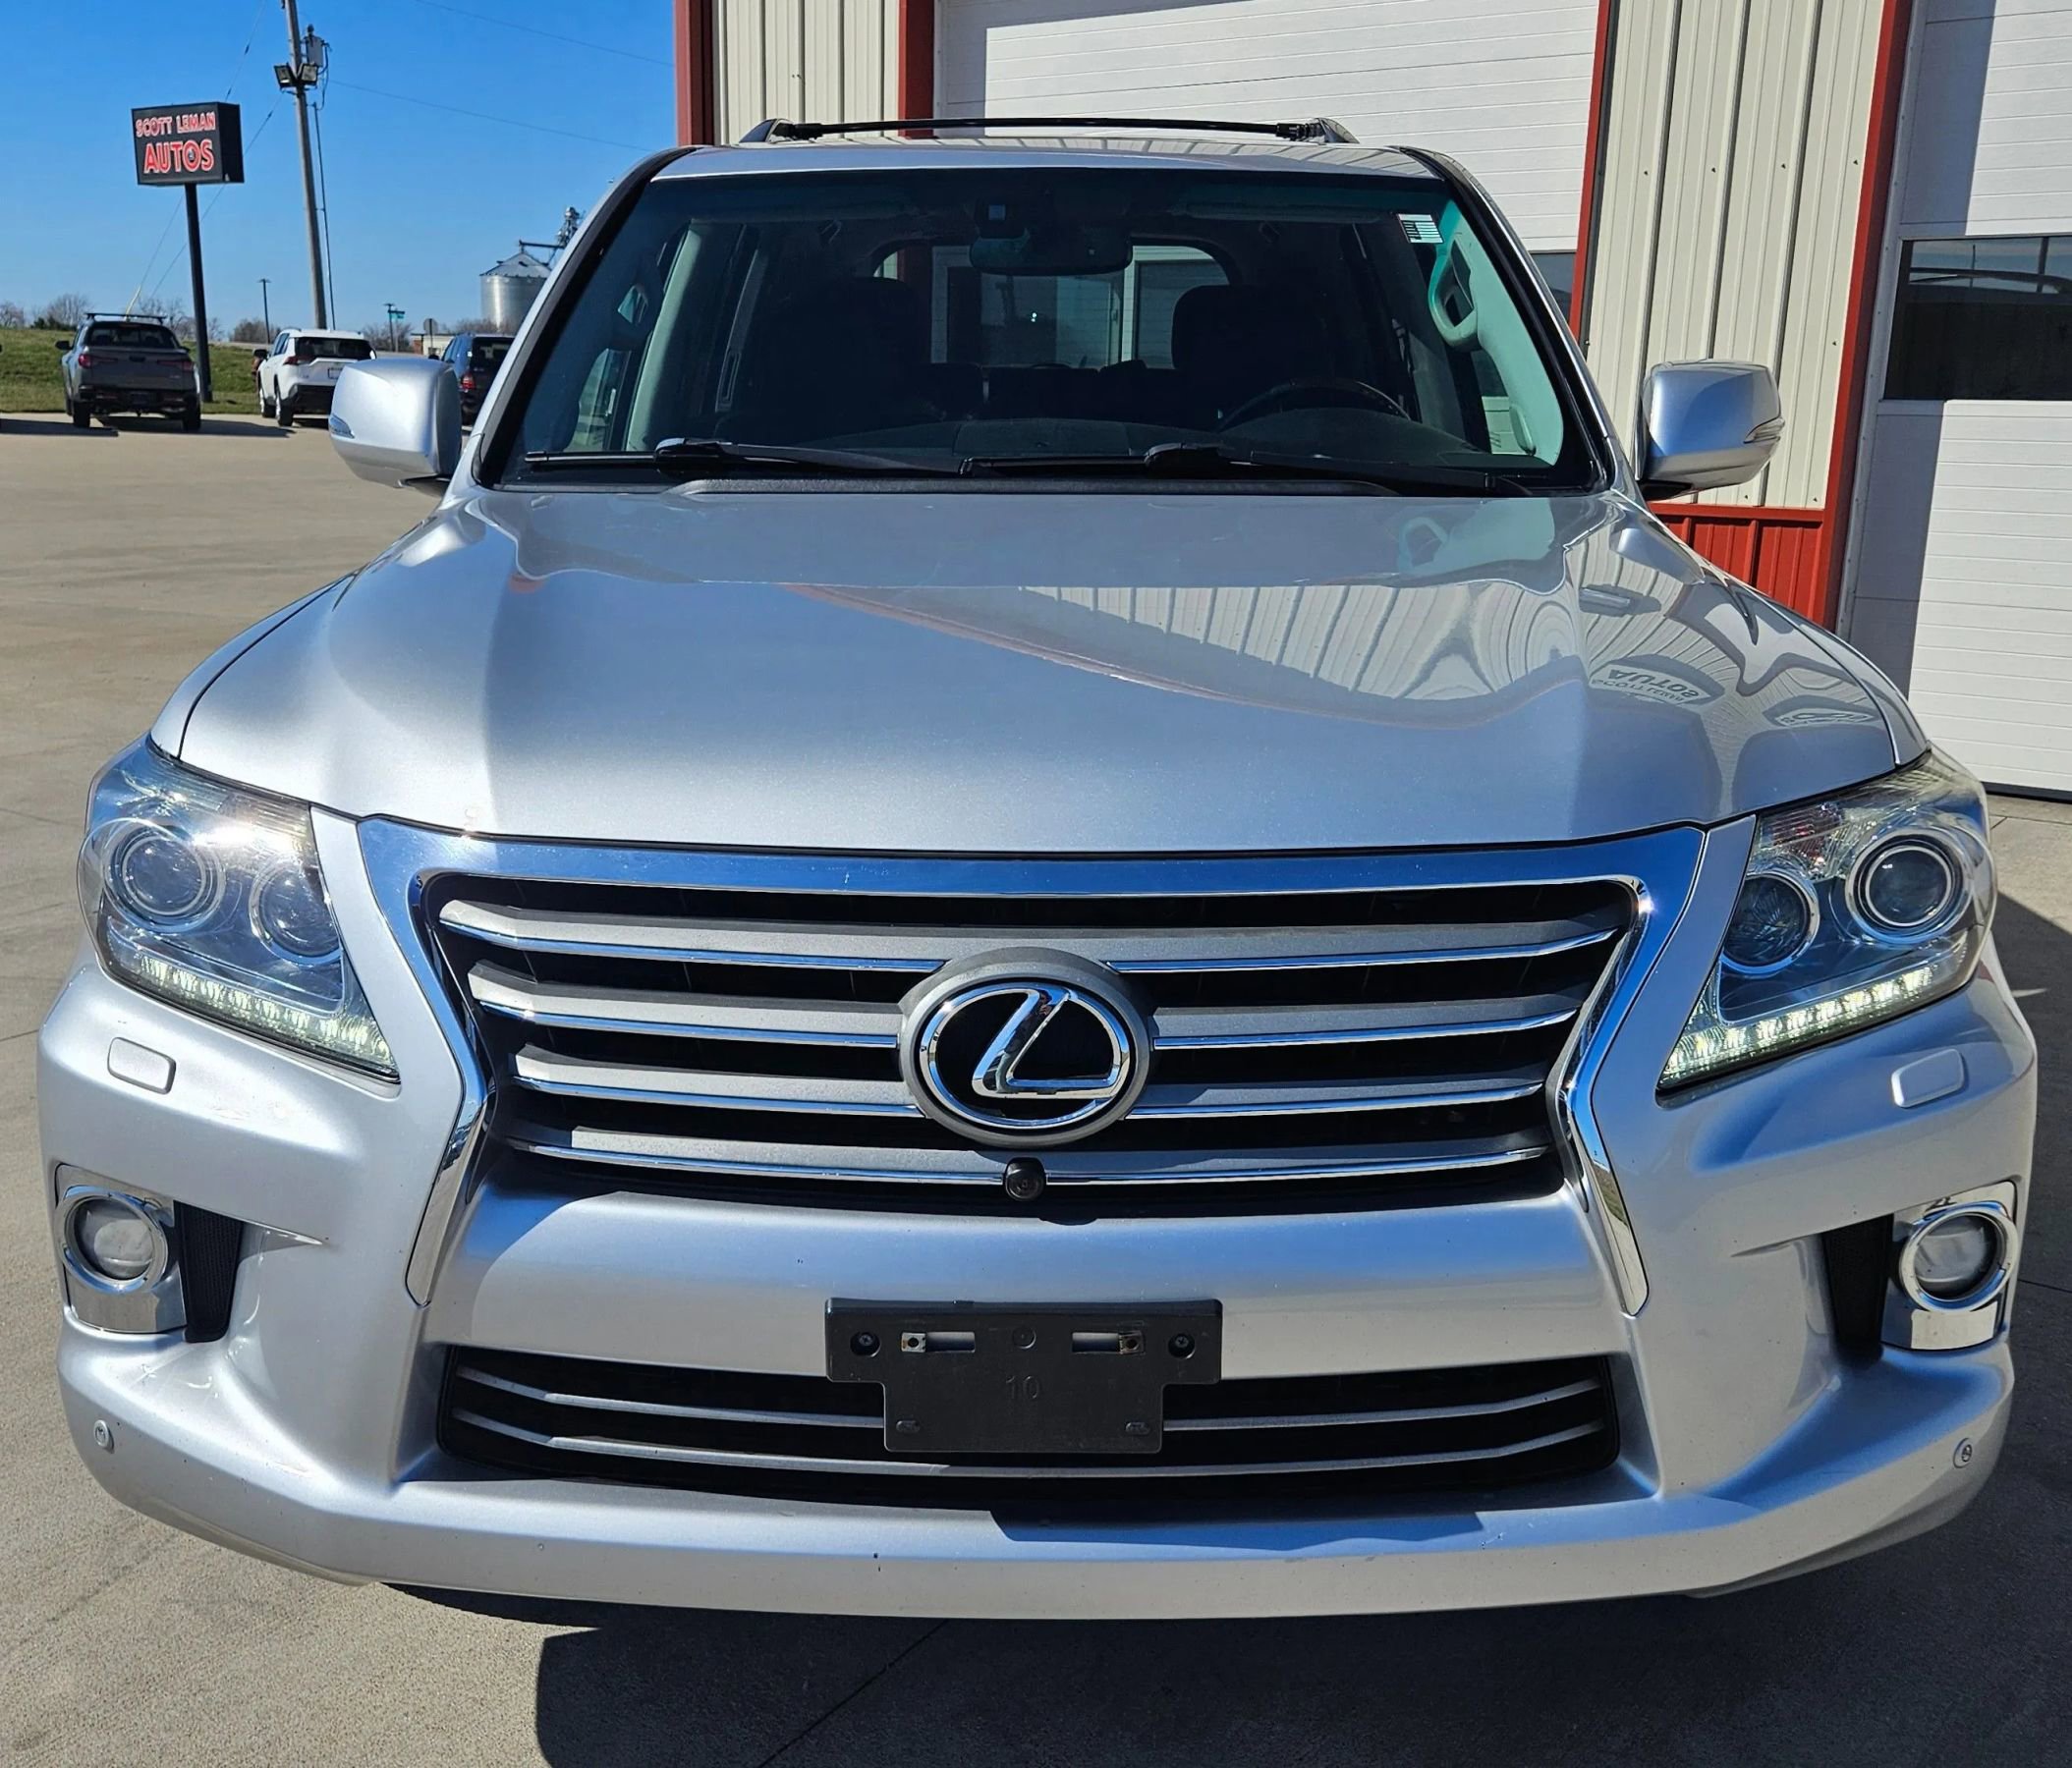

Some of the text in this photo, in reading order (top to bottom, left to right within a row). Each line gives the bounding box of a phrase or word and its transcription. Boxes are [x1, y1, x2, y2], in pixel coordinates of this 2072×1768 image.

[136, 111, 216, 138] SCOTT LEMAN
[143, 138, 214, 174] AUTOS
[1005, 1375, 1040, 1400] 10
